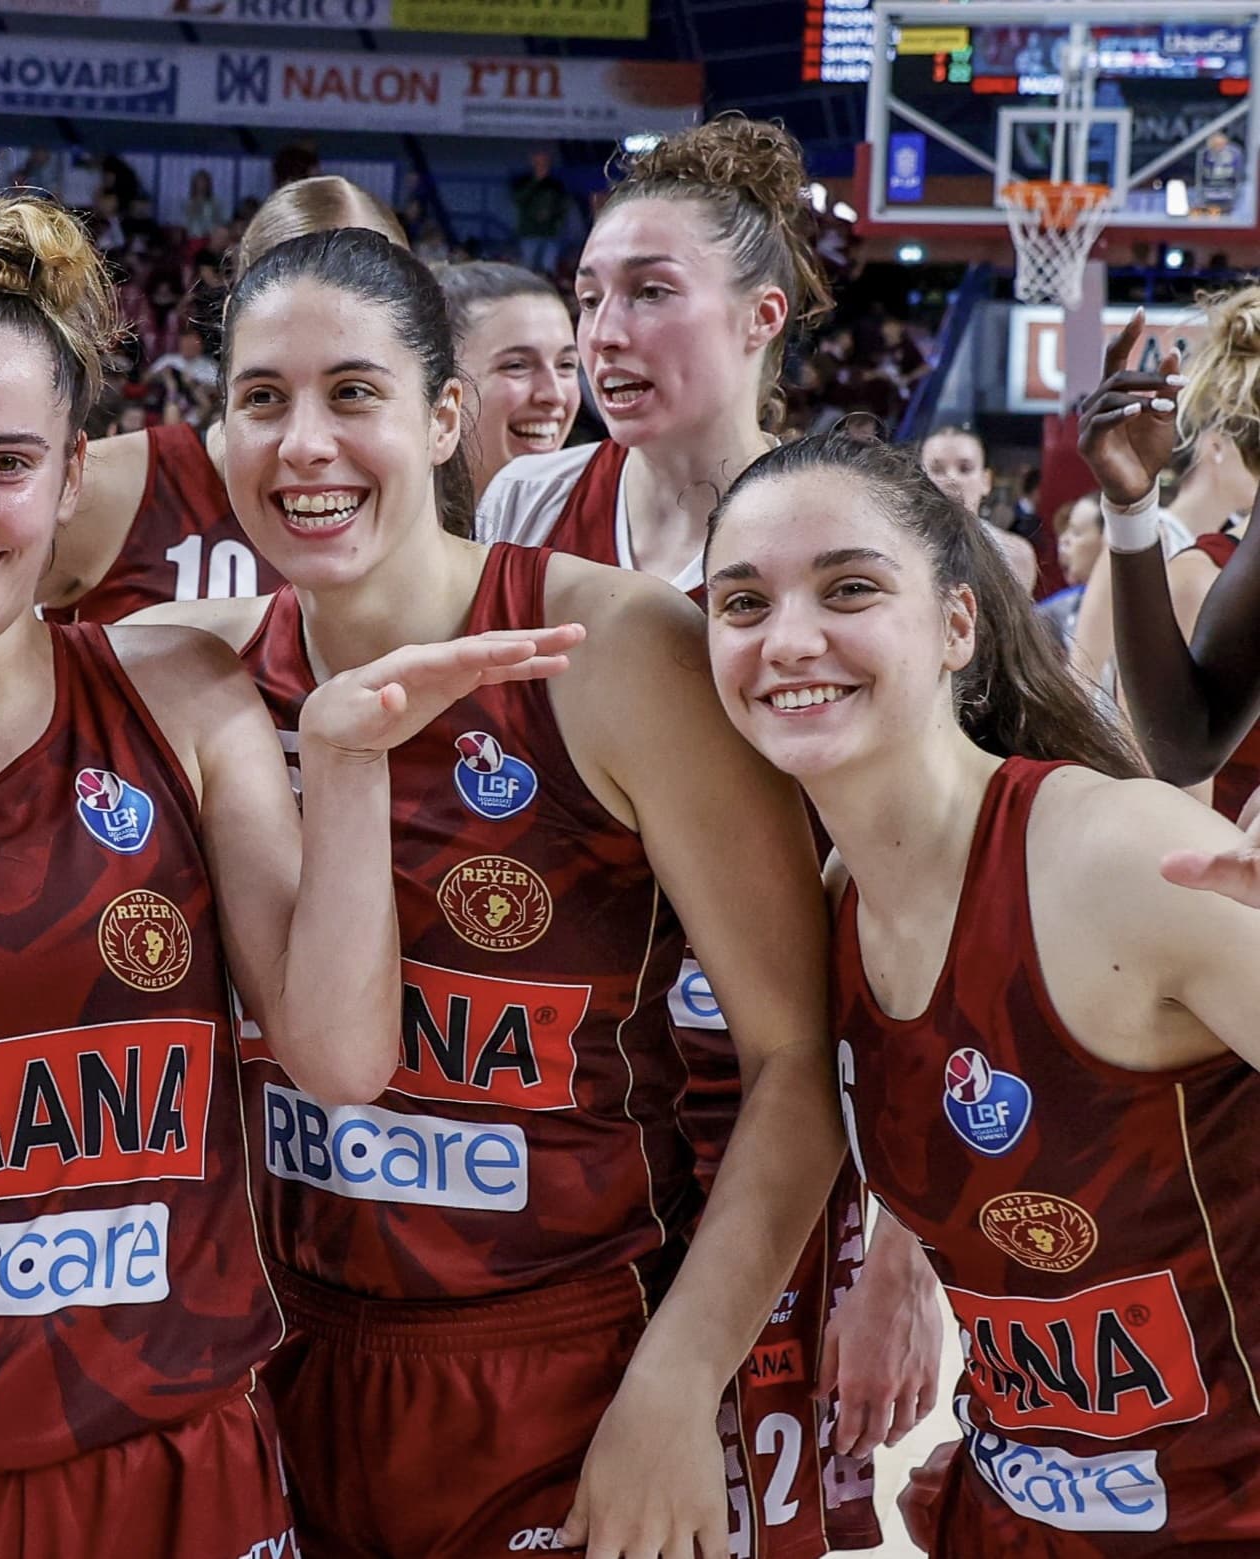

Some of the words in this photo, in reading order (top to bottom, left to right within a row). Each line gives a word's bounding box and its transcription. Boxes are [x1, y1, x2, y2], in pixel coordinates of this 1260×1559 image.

[283, 62, 440, 106] NALON
[464, 59, 563, 98] rm
[166, 534, 258, 602] 10
[477, 774, 520, 799] LBF
[461, 867, 528, 887] REYER
[115, 903, 172, 920] REYER
[465, 927, 522, 948] VENEZIA
[130, 971, 176, 988] VENEZIA
[966, 1100, 1010, 1130] LBF
[267, 1090, 521, 1196] RBcare
[988, 1201, 1059, 1223] REYER
[1030, 1253, 1081, 1269] VENEZIA
[746, 1349, 793, 1379] ANA
[755, 1412, 802, 1526] 2
